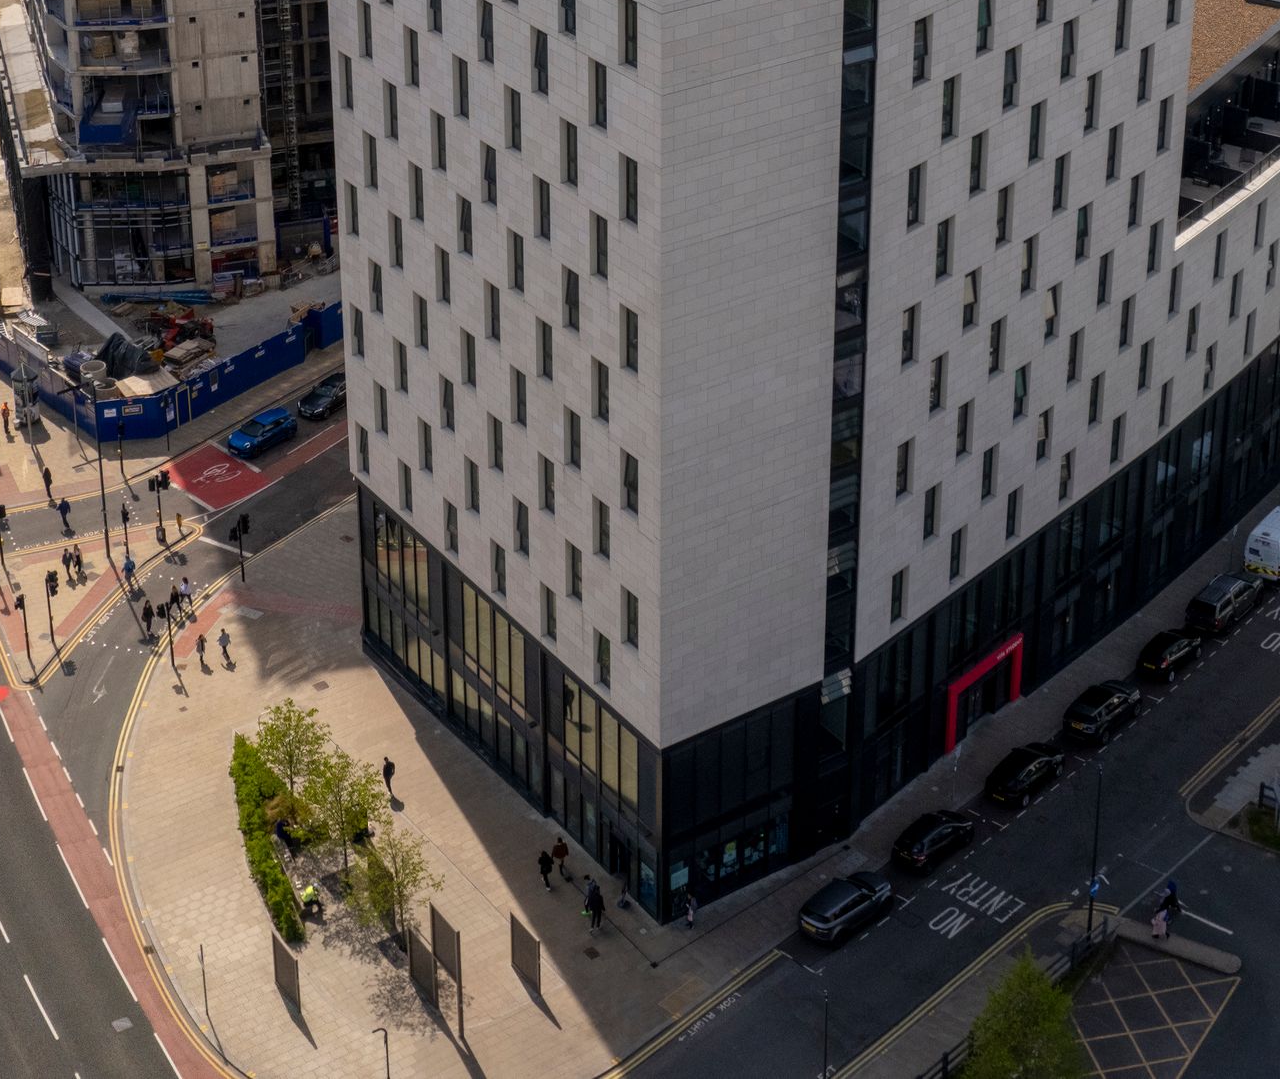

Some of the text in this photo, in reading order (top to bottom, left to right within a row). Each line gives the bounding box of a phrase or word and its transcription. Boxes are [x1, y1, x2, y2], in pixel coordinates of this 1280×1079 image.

[928, 872, 1027, 939] NO ENTRY
[688, 992, 743, 1038] LOOK RIGHT
